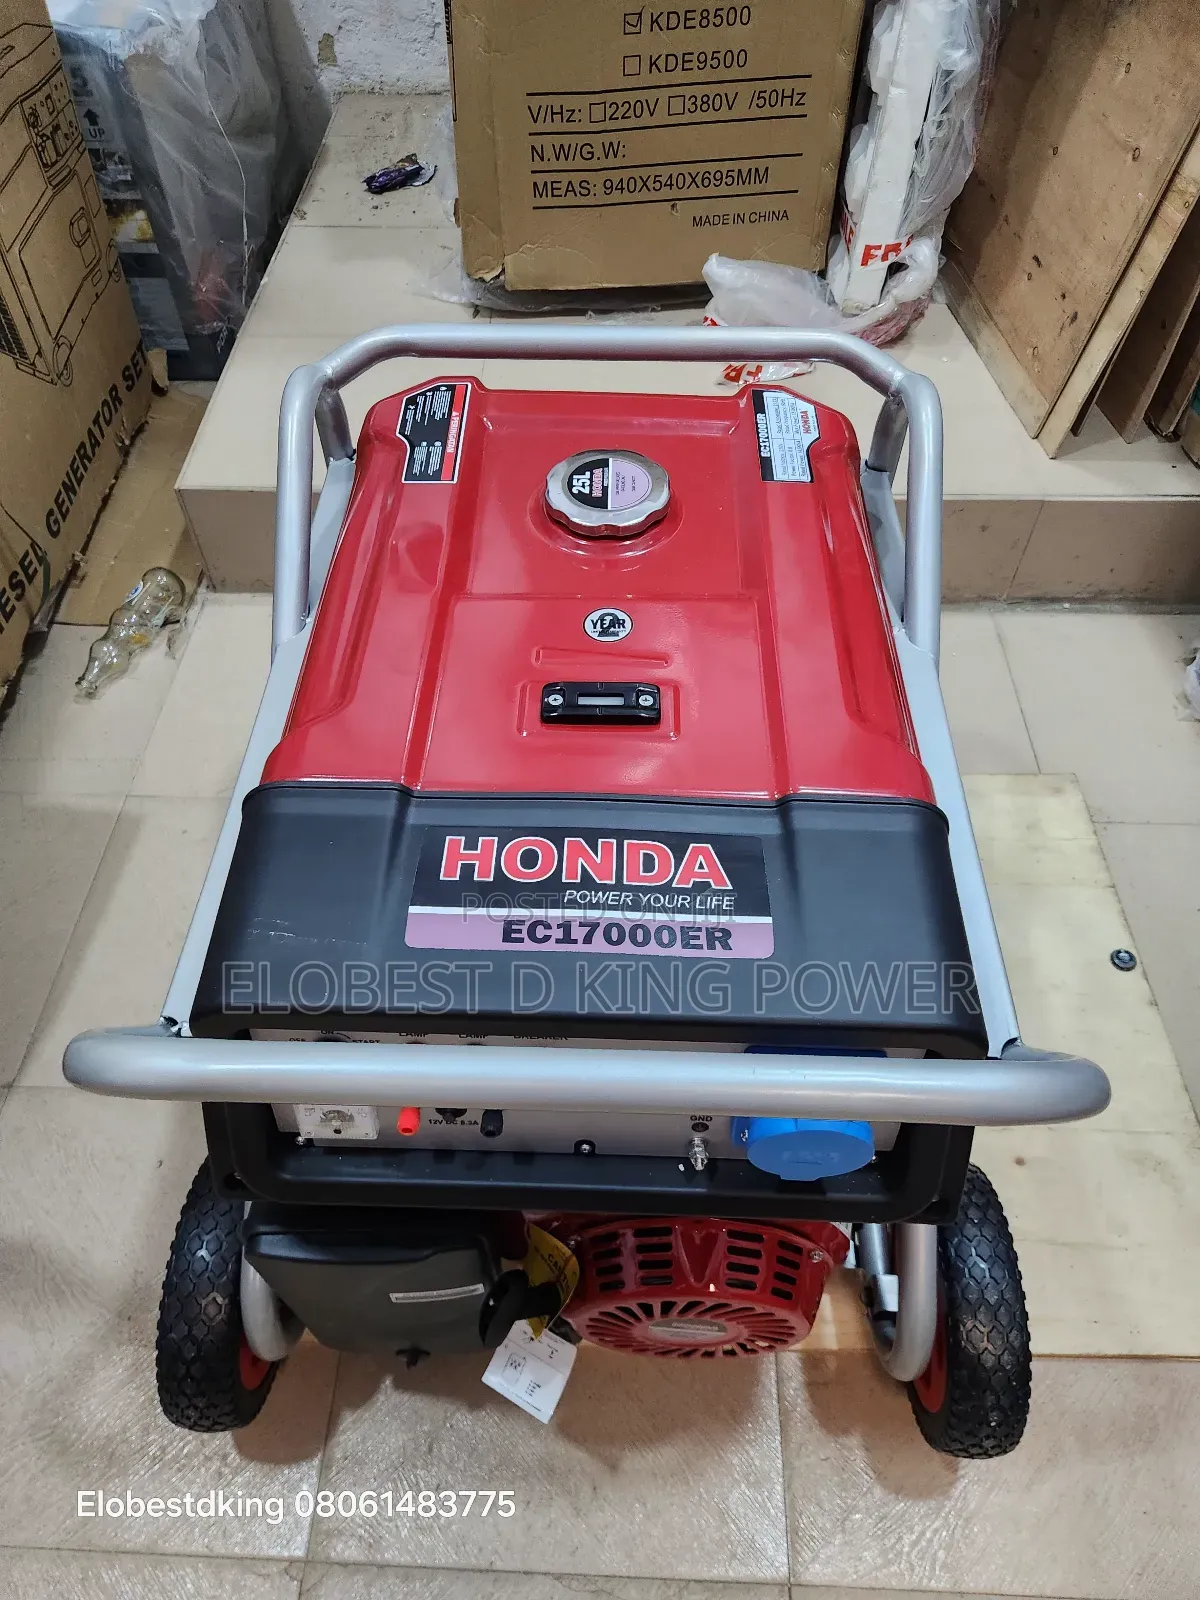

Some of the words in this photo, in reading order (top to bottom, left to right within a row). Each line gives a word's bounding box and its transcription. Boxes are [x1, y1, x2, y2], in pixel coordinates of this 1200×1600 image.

[650, 6, 751, 32] KDE8500
[649, 49, 748, 74] KDE9500
[528, 104, 582, 124] V/Hz:
[608, 99, 659, 121] 220V
[687, 93, 739, 113] 380V
[748, 88, 807, 110] /50Hz
[530, 140, 626, 163] N.W/G.W:
[533, 180, 597, 199] MEAS:
[603, 166, 769, 195] 940X540X695MM
[692, 213, 731, 228] MADE
[733, 212, 745, 226] IN
[748, 209, 789, 225] CHINA
[758, 413, 771, 457] EC17000ER
[800, 410, 812, 435] HONDA
[45, 383, 123, 539] GENERATOR
[121, 338, 147, 392] SET
[571, 471, 591, 494] 25L
[591, 467, 603, 498] HONDA
[590, 618, 627, 629] YEAR
[439, 835, 734, 890] HONDA
[563, 890, 632, 906] POWER
[639, 893, 691, 909] YOUR
[695, 896, 735, 911] LIFE
[501, 918, 733, 951] EC17000ER
[690, 1114, 713, 1123] GND
